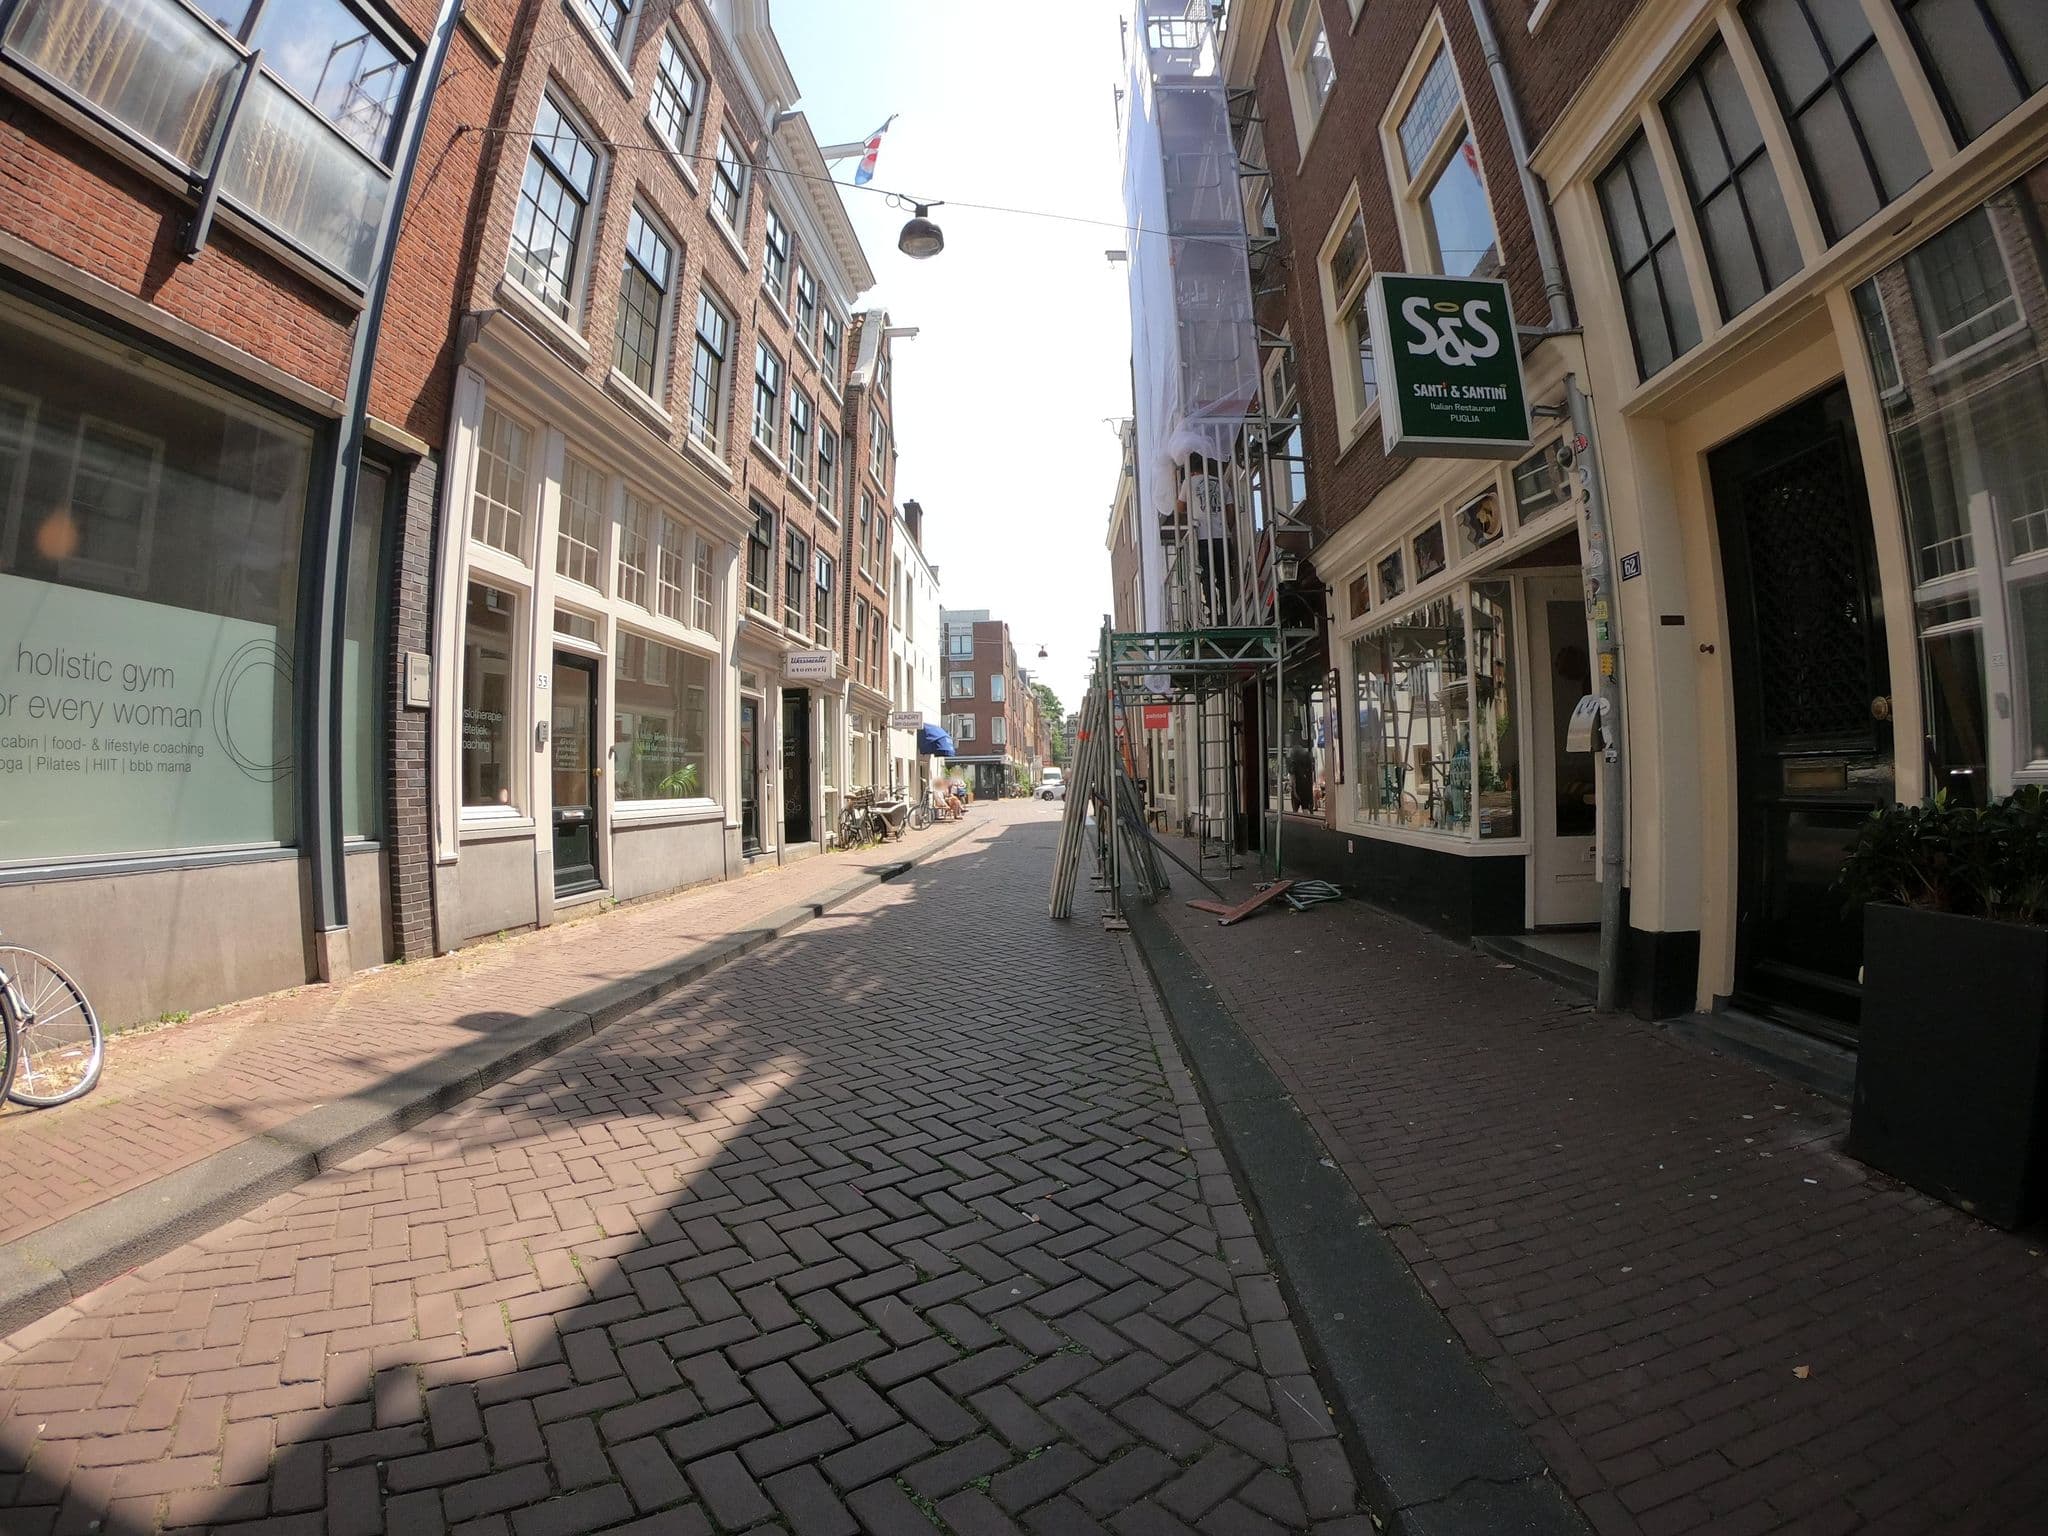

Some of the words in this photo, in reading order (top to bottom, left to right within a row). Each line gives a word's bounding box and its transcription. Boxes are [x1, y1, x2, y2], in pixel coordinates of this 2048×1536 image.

[1450, 385, 1460, 399] &
[1430, 402, 1453, 411] Italian
[1454, 403, 1496, 412] Restaurant
[1450, 414, 1480, 423] PUGLIA
[1624, 558, 1636, 576] 62
[17, 641, 112, 683] holistic
[122, 663, 175, 692] gym
[538, 674, 548, 688] 53
[29, 695, 104, 728] every
[113, 701, 202, 729] woman
[91, 738, 101, 751] &
[104, 739, 150, 755] lifestyle
[153, 742, 204, 757] coaching
[37, 756, 81, 771] Pilates
[93, 758, 118, 771] HIIT
[129, 759, 153, 772] bbb
[157, 762, 192, 773] mama
